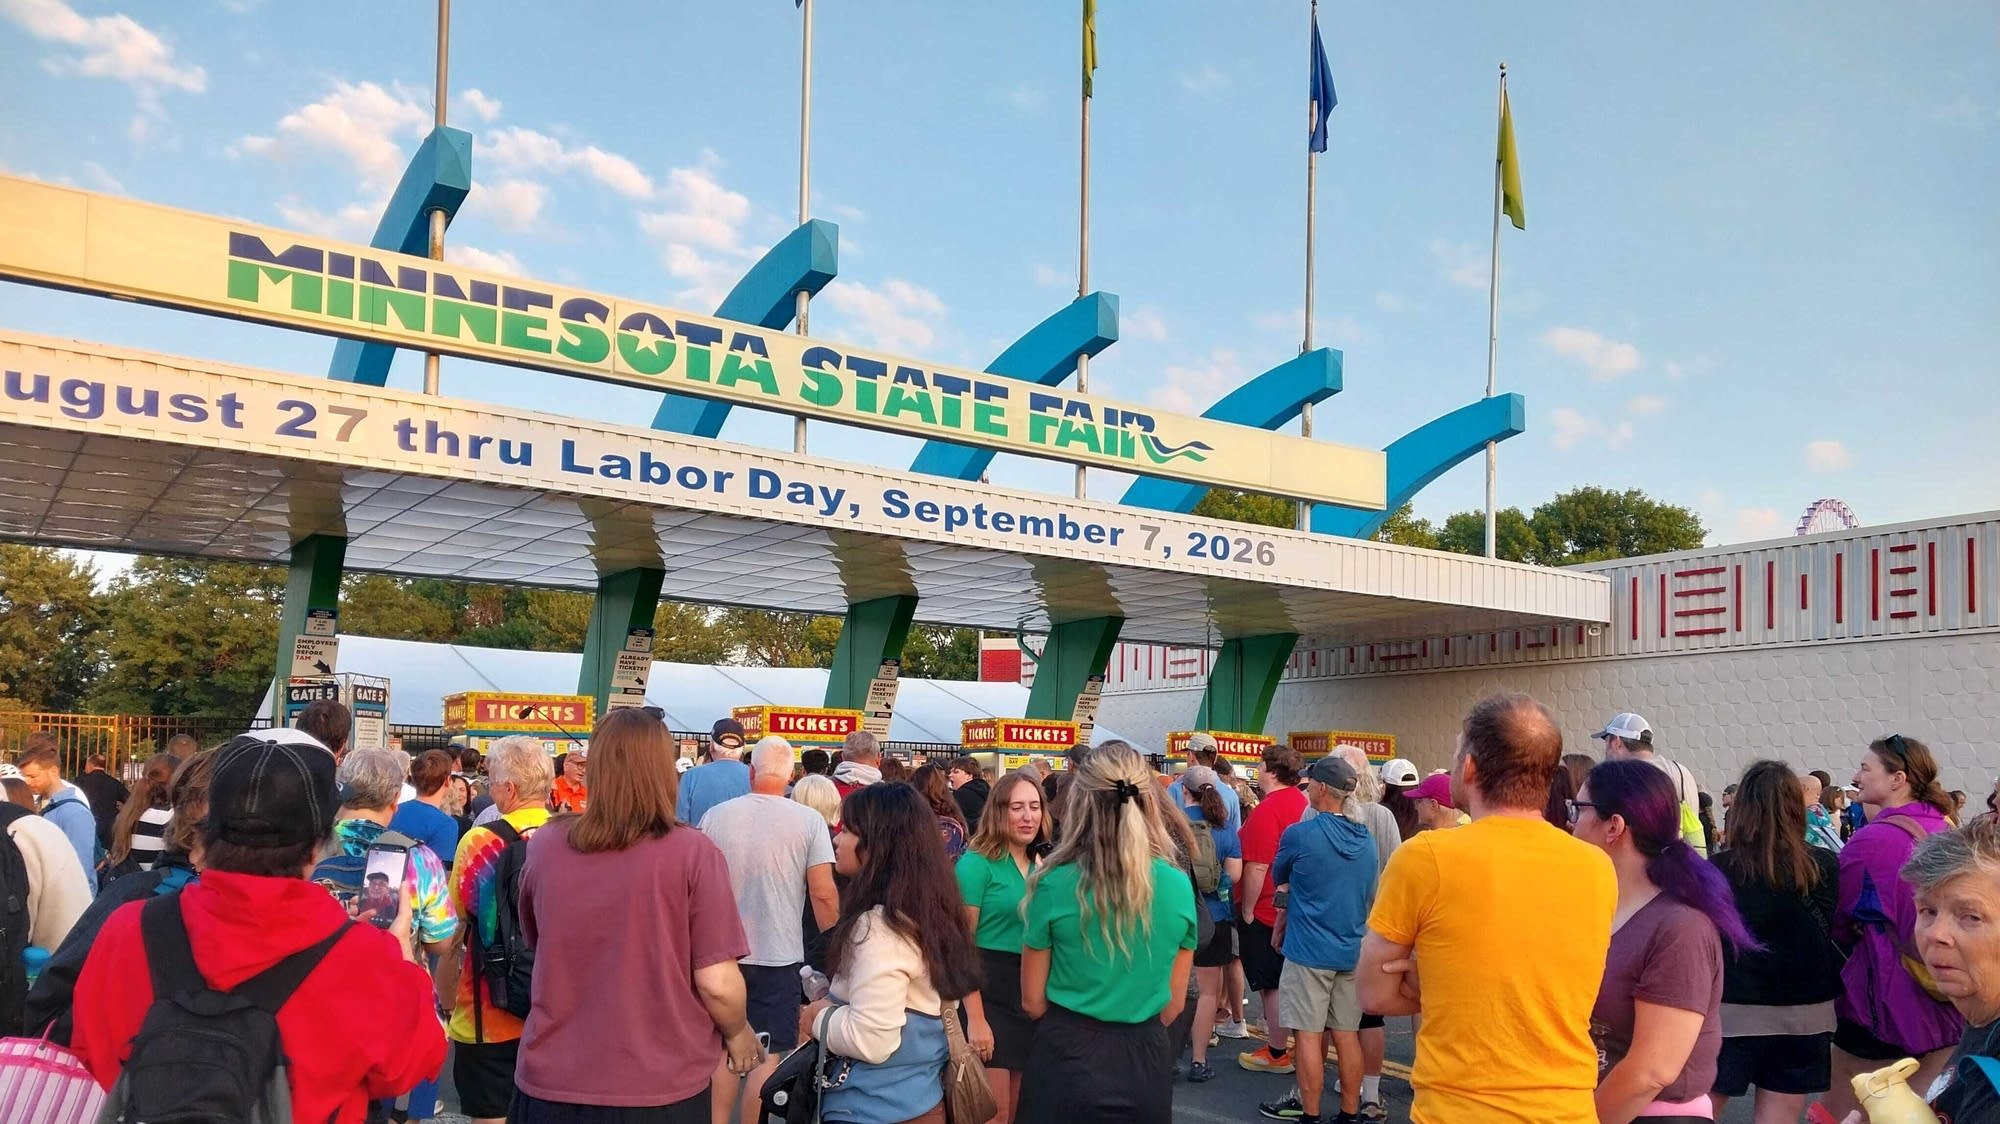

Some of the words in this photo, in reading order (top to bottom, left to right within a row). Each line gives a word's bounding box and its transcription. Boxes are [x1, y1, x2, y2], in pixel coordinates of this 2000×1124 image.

[227, 231, 781, 397] MINNESOTA
[799, 346, 1009, 438] STATE
[1029, 392, 1214, 464] FAIR
[3, 370, 245, 429] ugust
[274, 400, 369, 443] 27
[393, 418, 533, 467] thru
[561, 439, 735, 494] Labor
[748, 467, 861, 519] Day,
[882, 489, 1126, 547] September
[1139, 524, 1172, 559] 7,
[1187, 531, 1276, 567] 2026
[291, 688, 323, 701] GATE
[326, 687, 334, 700] 5
[356, 687, 377, 701] GATE
[377, 690, 384, 703] 5
[778, 716, 849, 732] TICKETS
[968, 727, 995, 740] TICKETS
[1010, 727, 1068, 742] TICKETS
[1295, 739, 1327, 751] TICKETS
